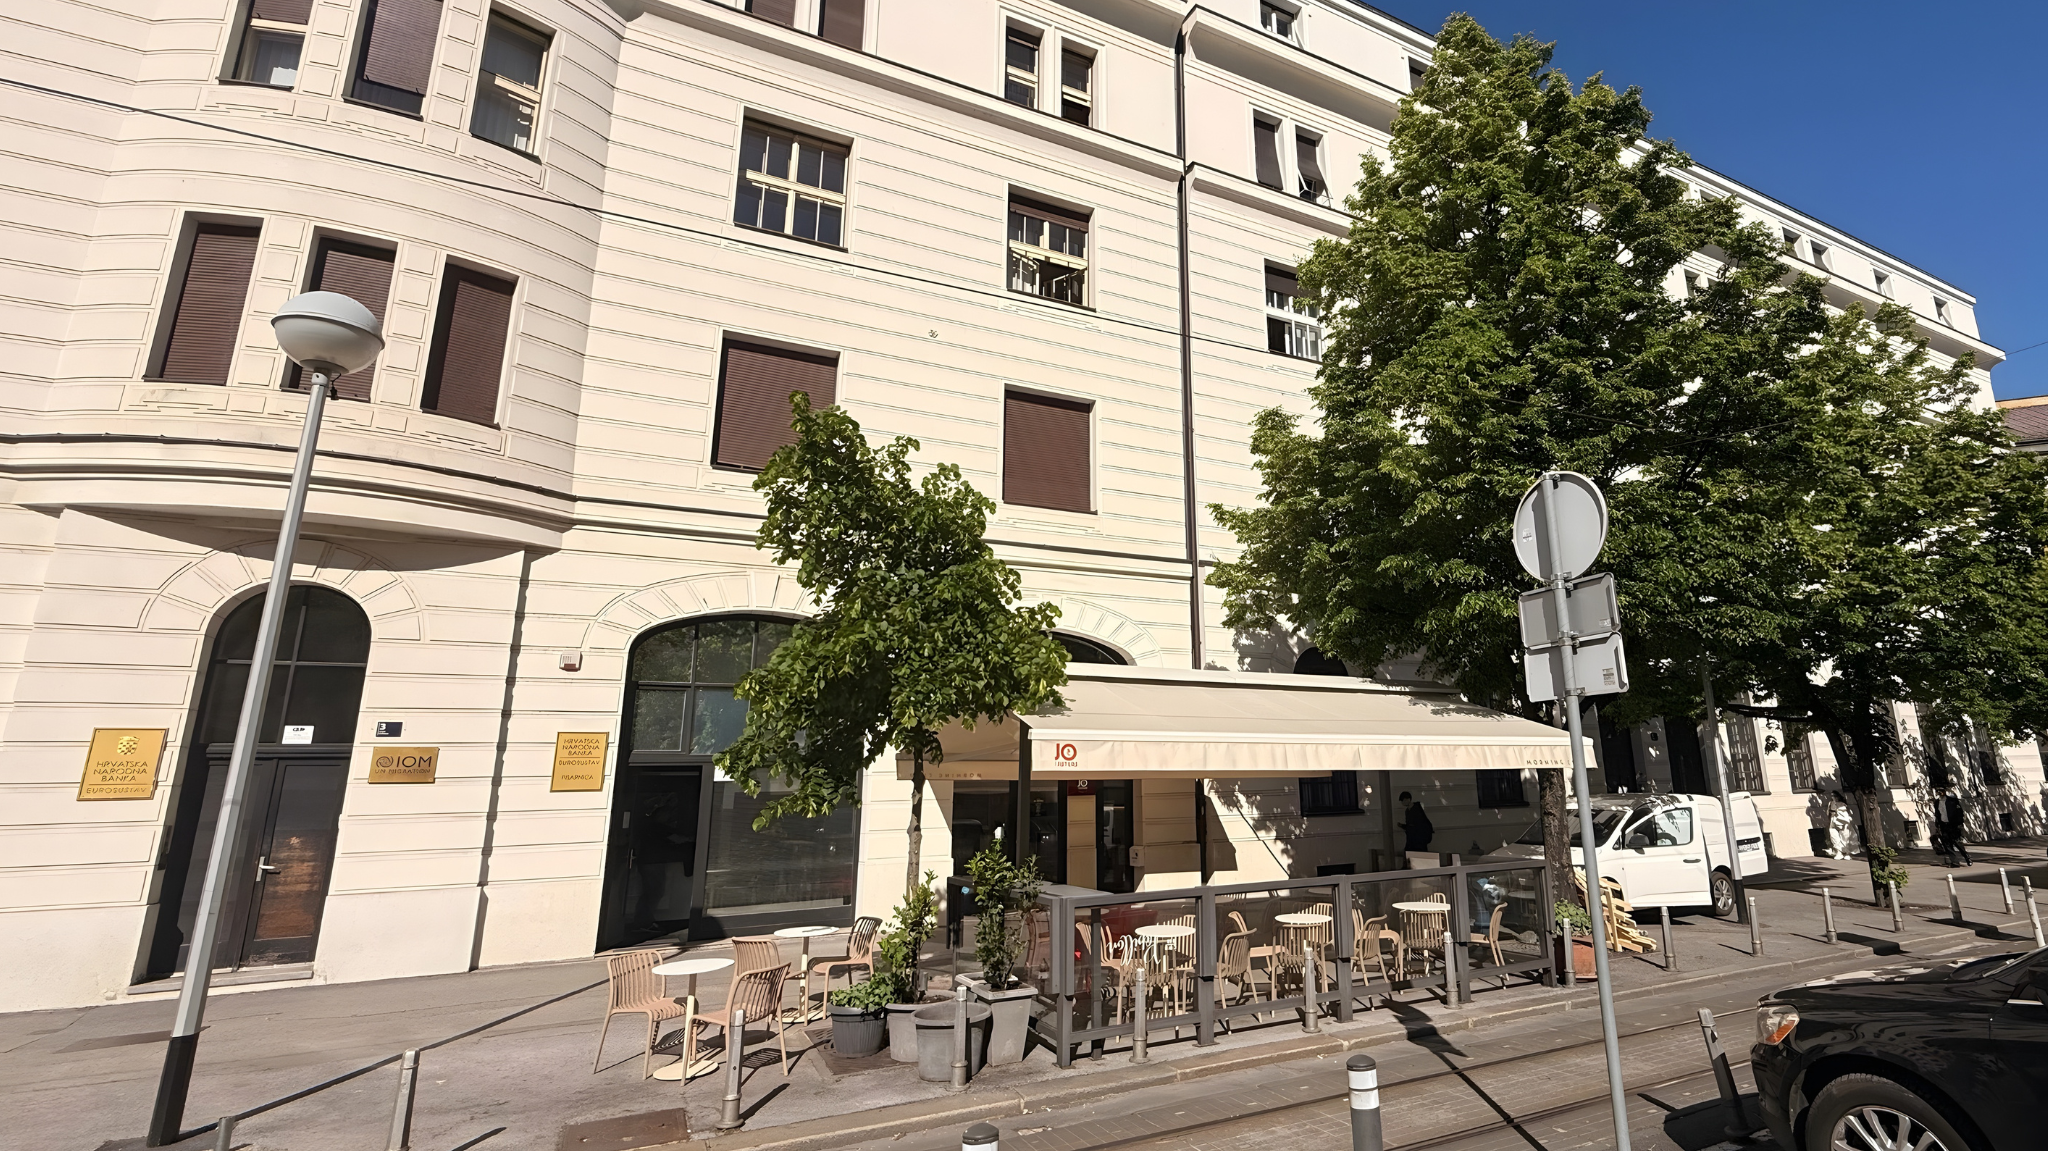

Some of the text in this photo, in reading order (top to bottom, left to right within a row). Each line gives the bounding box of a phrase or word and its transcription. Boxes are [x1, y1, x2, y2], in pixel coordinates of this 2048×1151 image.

[379, 723, 387, 731] 3
[1054, 743, 1078, 761] JO
[96, 760, 148, 768] HRVATSKA
[396, 756, 433, 768] IOM
[93, 767, 147, 775] NARODNA
